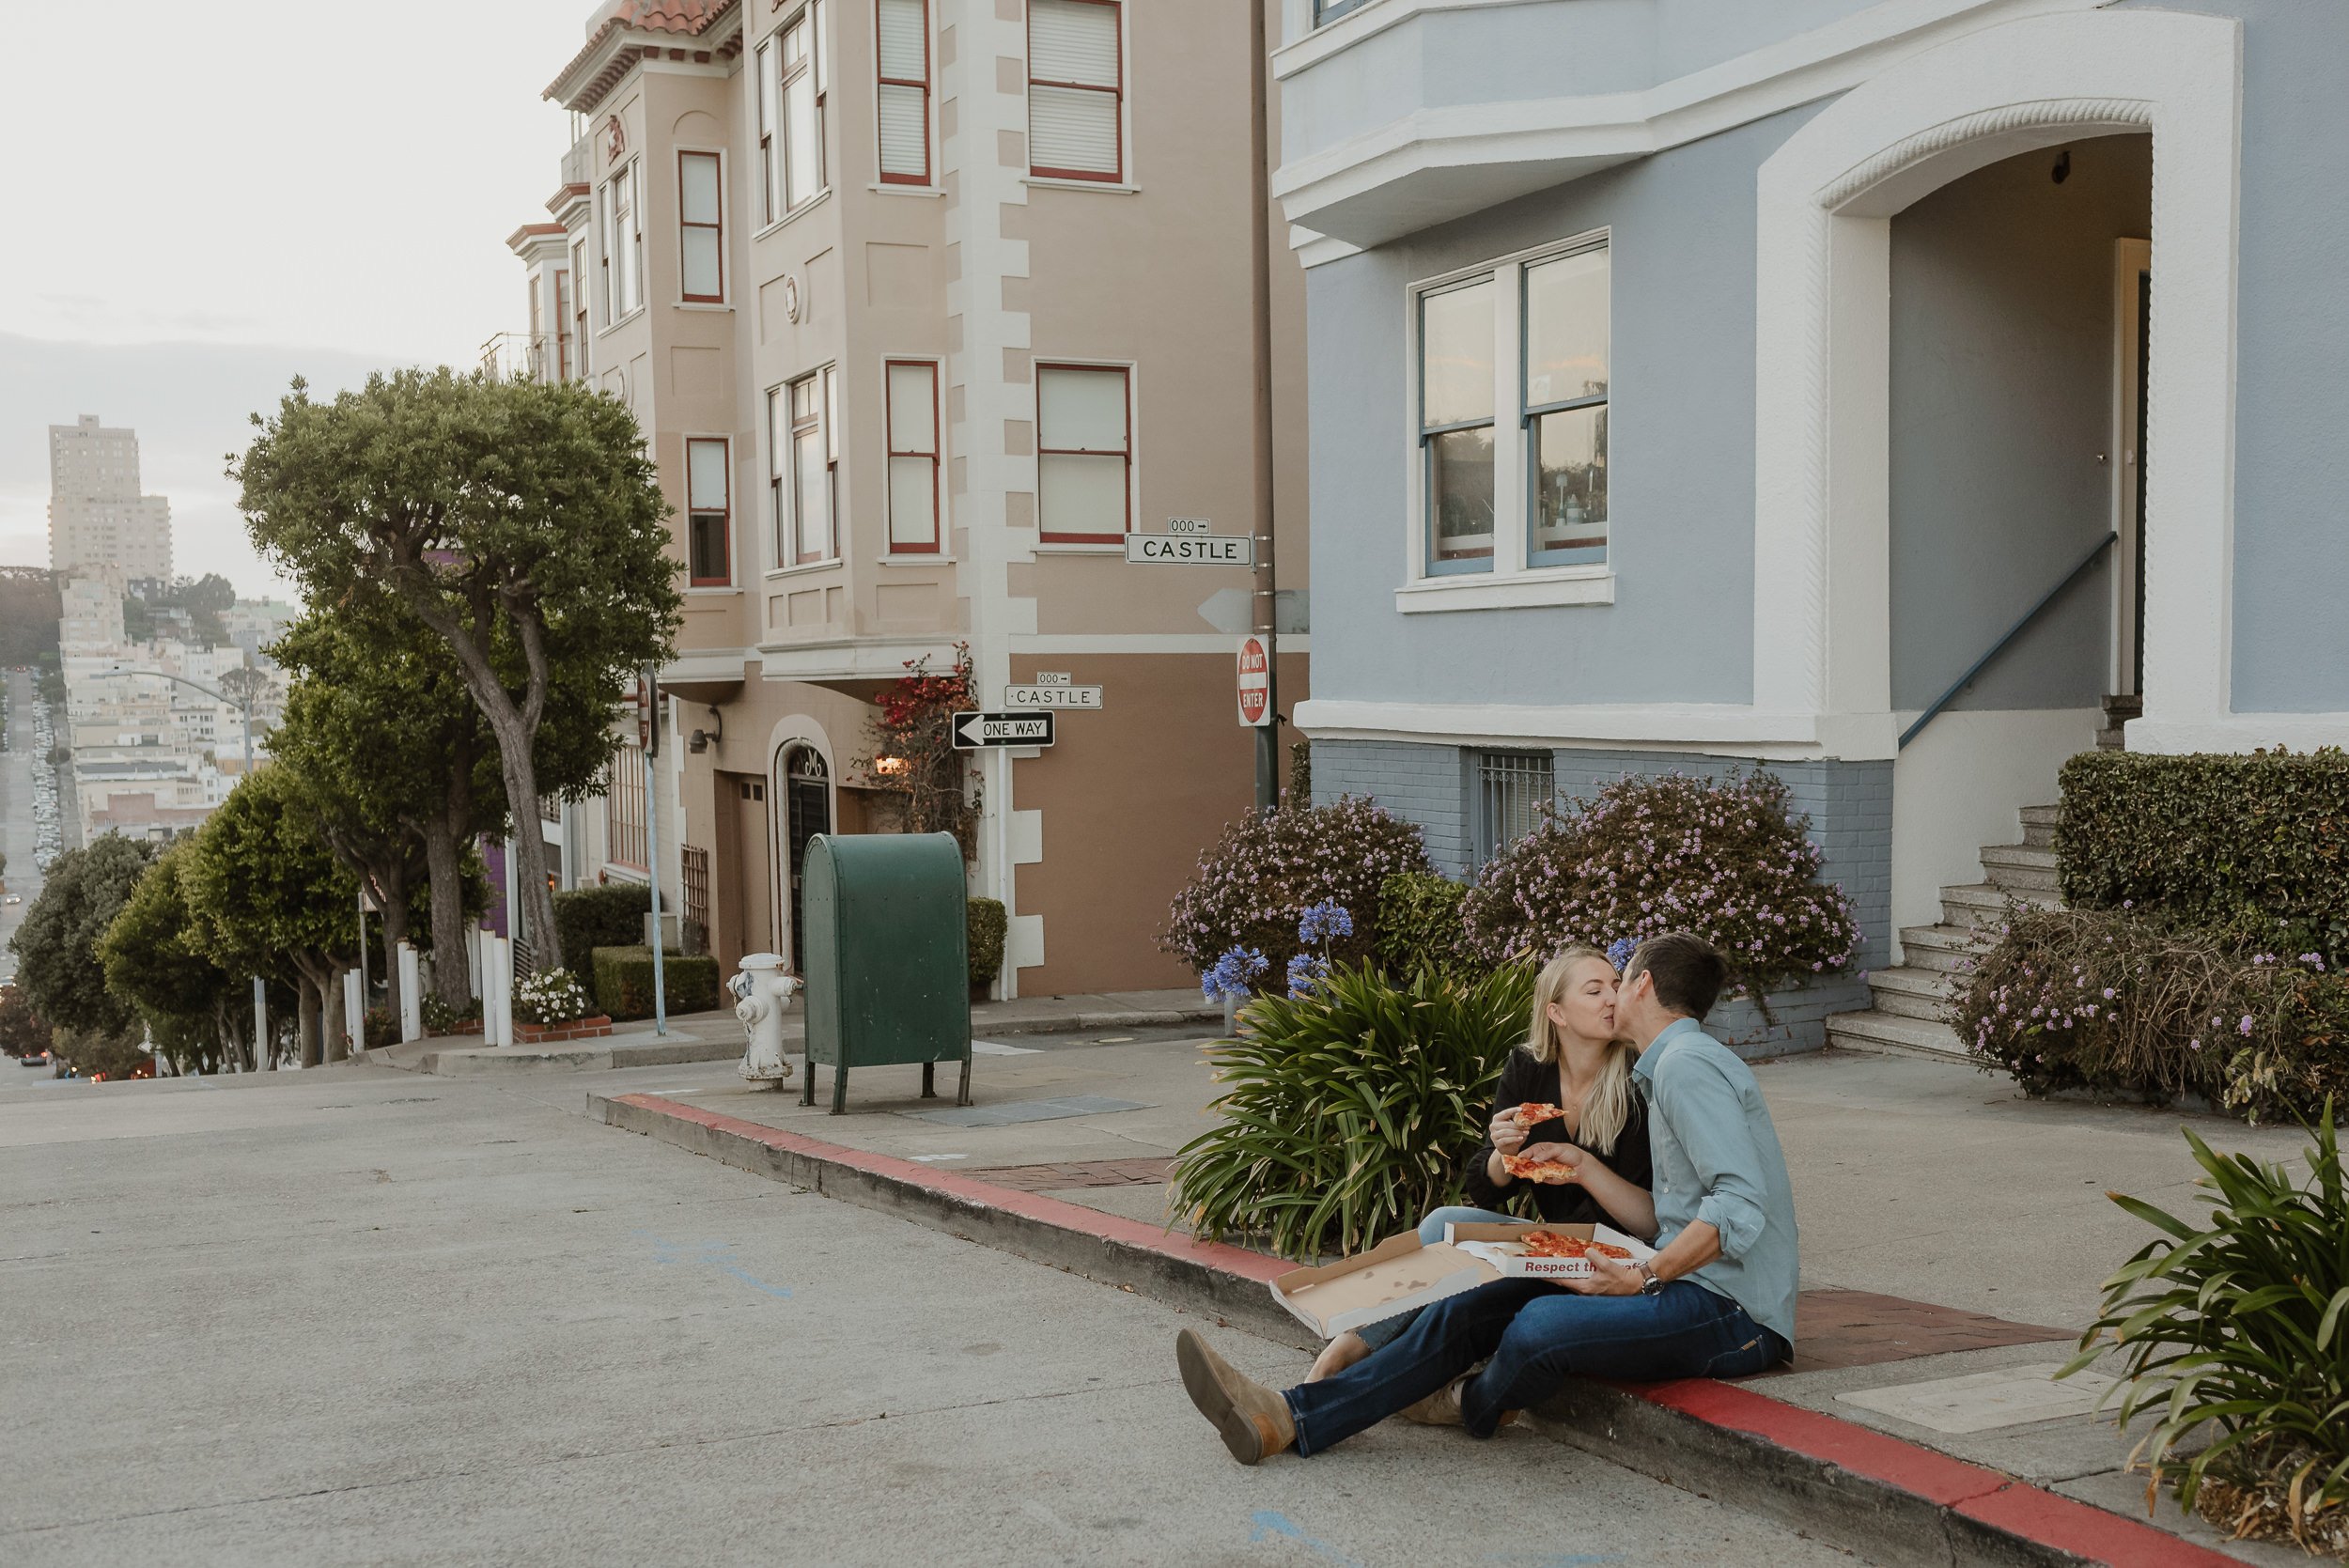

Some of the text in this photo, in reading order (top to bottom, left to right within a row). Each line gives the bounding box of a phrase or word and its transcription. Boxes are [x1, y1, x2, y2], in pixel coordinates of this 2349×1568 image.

[1143, 540, 1237, 559] CASTLE
[1242, 653, 1263, 670] DO NOT
[1017, 691, 1090, 704] CASTLE
[1243, 692, 1263, 708] ENTER
[983, 722, 1043, 736] ONE WAY
[1524, 1261, 1597, 1274] Respect th
